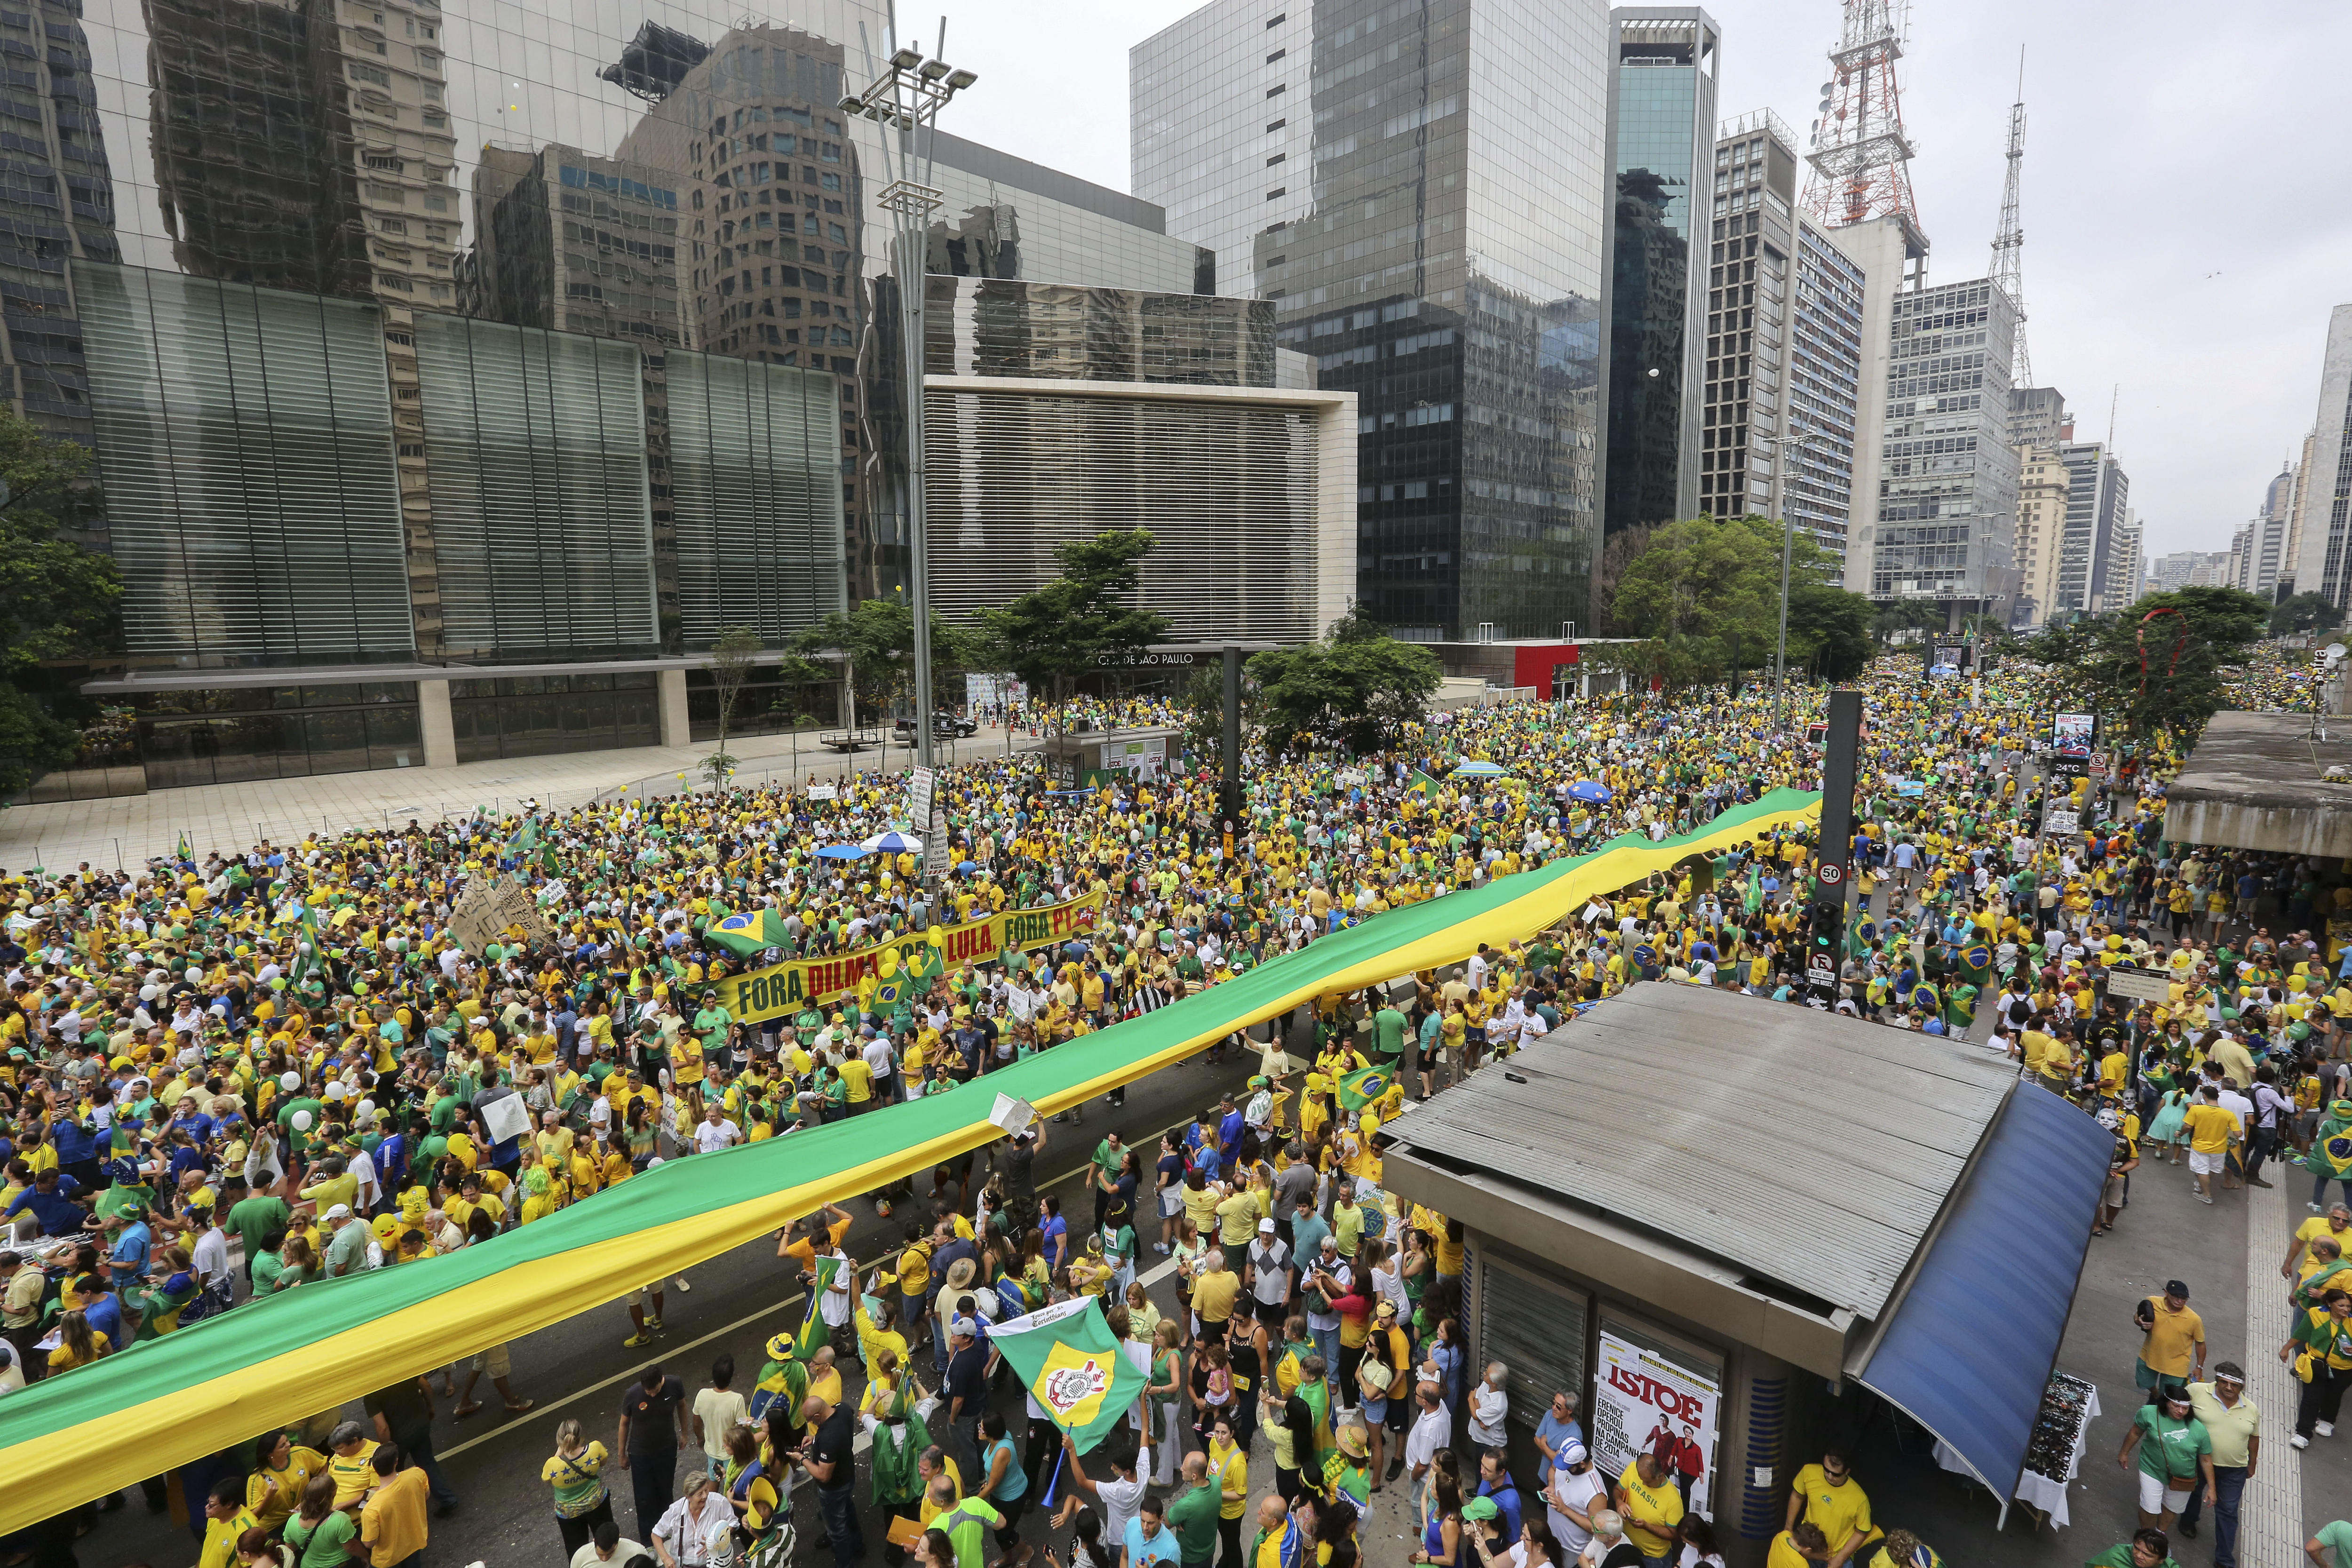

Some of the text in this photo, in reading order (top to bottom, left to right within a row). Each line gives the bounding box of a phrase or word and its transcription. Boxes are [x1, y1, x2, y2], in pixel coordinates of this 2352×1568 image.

[1162, 653, 1193, 664] PAULO
[2056, 764, 2080, 772] 24°C
[1494, 865, 1502, 876] 10
[1823, 868, 1839, 878] 50
[550, 883, 560, 891] NA
[588, 950, 596, 963] 10
[738, 969, 804, 1015] FORA
[947, 924, 997, 963] LULA,
[1005, 912, 1050, 947] FORA
[1053, 905, 1073, 935] PT
[961, 1040, 973, 1049] JFK
[414, 1203, 421, 1213] 3
[1413, 1210, 1427, 1224] BRASIL
[1032, 1311, 1067, 1327] Corinthians
[1645, 1357, 1660, 1369] BILHETE
[1669, 1367, 1677, 1376] LIGA
[1678, 1372, 1691, 1382] DILMA
[1598, 1398, 1624, 1420] ERENICE
[1597, 1407, 1623, 1430] OPEROU
[1597, 1417, 1629, 1444] PROPINAS
[1595, 1436, 1603, 1449] DE
[1604, 1441, 1620, 1458] 2014
[1596, 1426, 1605, 1440] NA
[1606, 1432, 1639, 1458] CAMPANH
[1630, 1481, 1657, 1509] BRASIL
